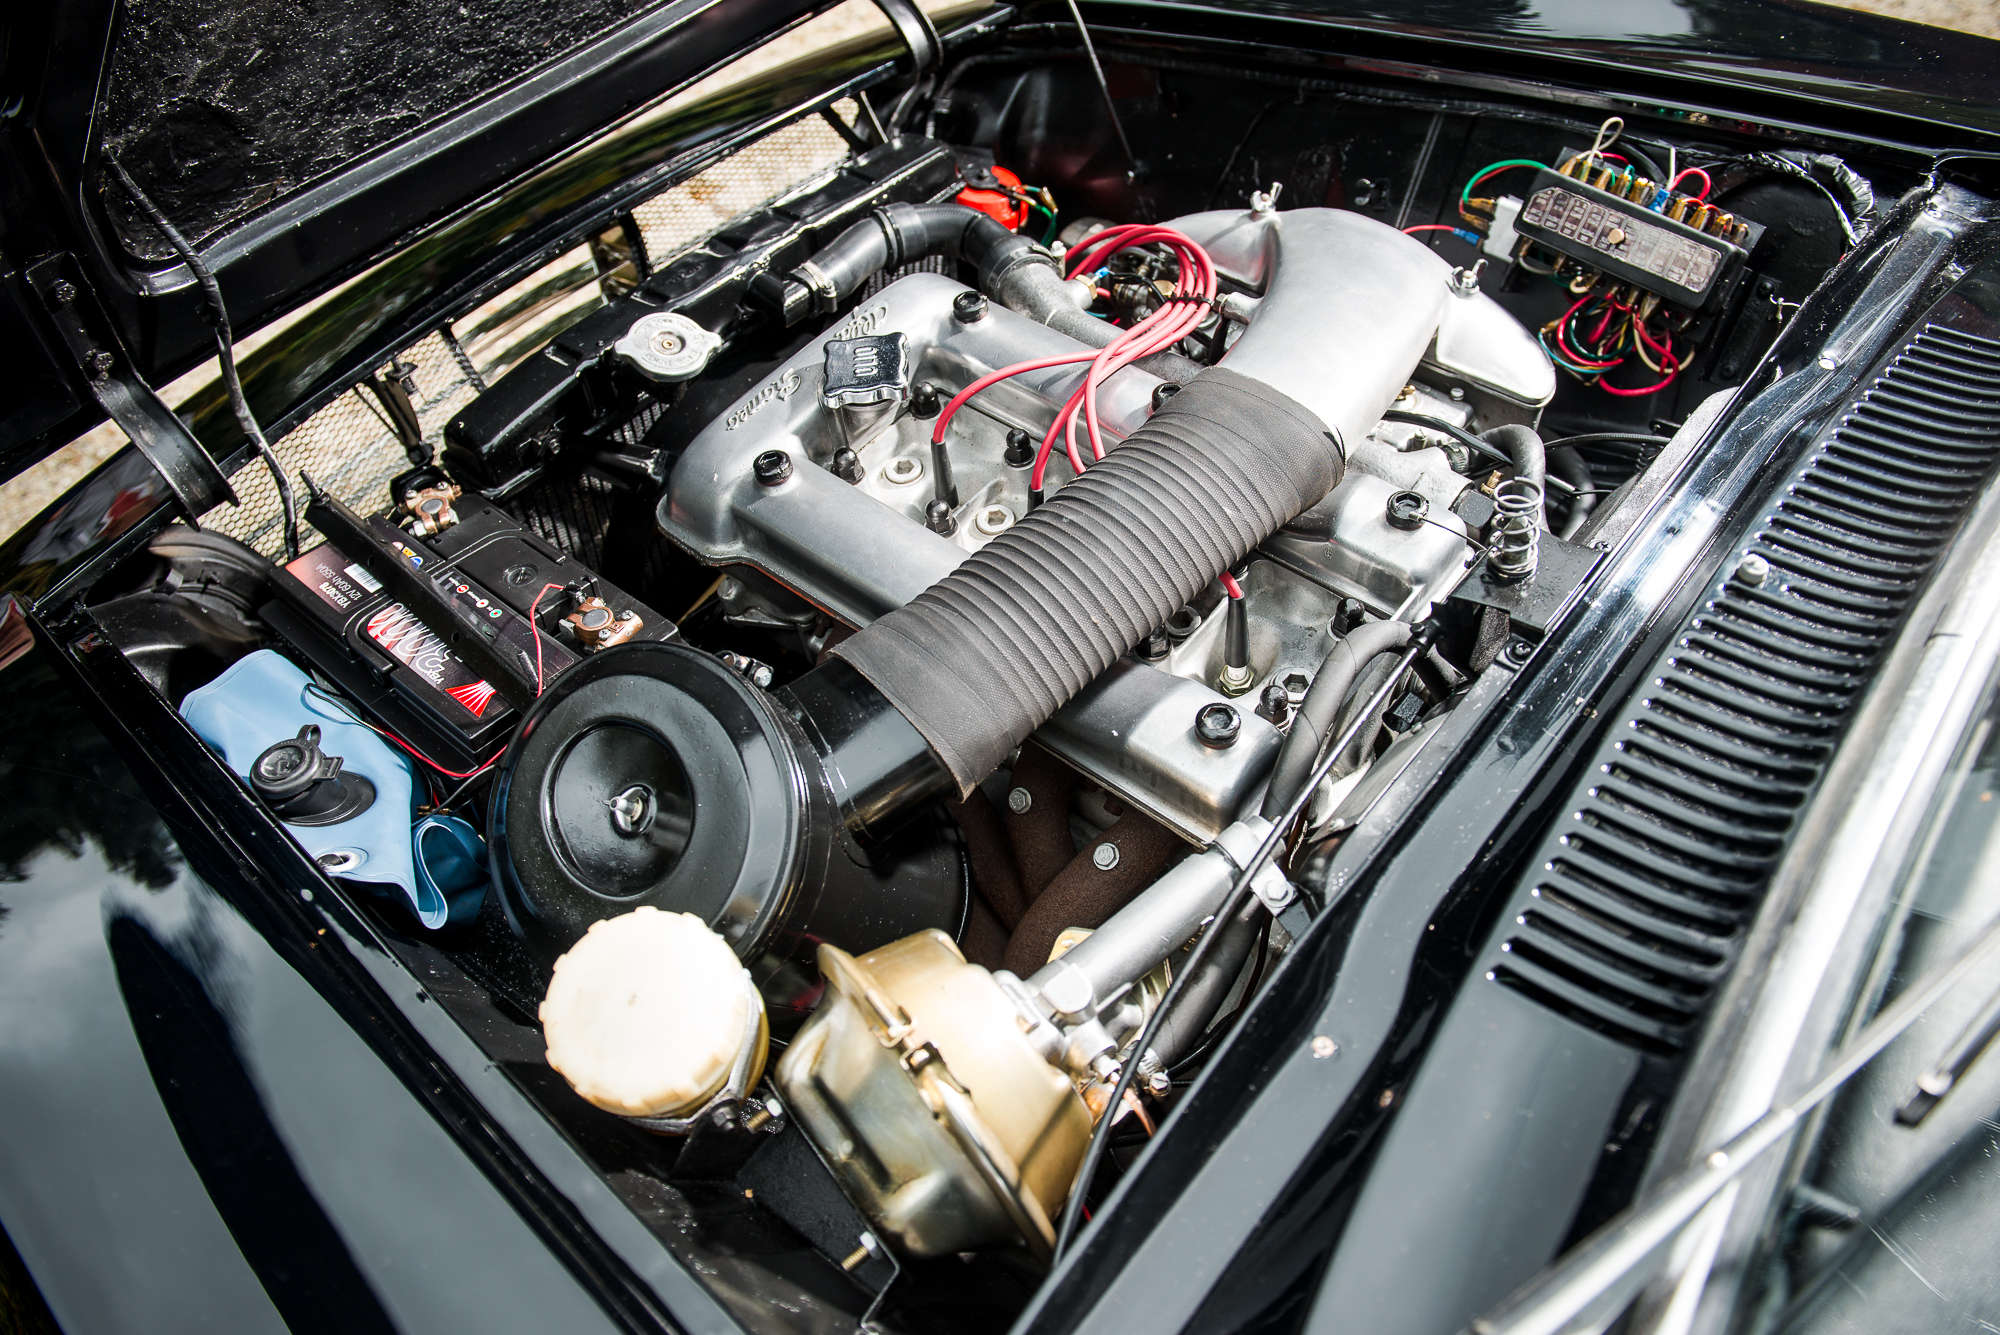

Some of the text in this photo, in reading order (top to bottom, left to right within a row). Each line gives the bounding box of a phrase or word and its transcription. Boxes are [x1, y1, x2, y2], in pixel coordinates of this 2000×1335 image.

[726, 368, 801, 431] Romeo
[315, 561, 363, 602] 12V 60Ah 550A
[318, 579, 352, 609] YBX3078
[425, 668, 444, 685] YBX
